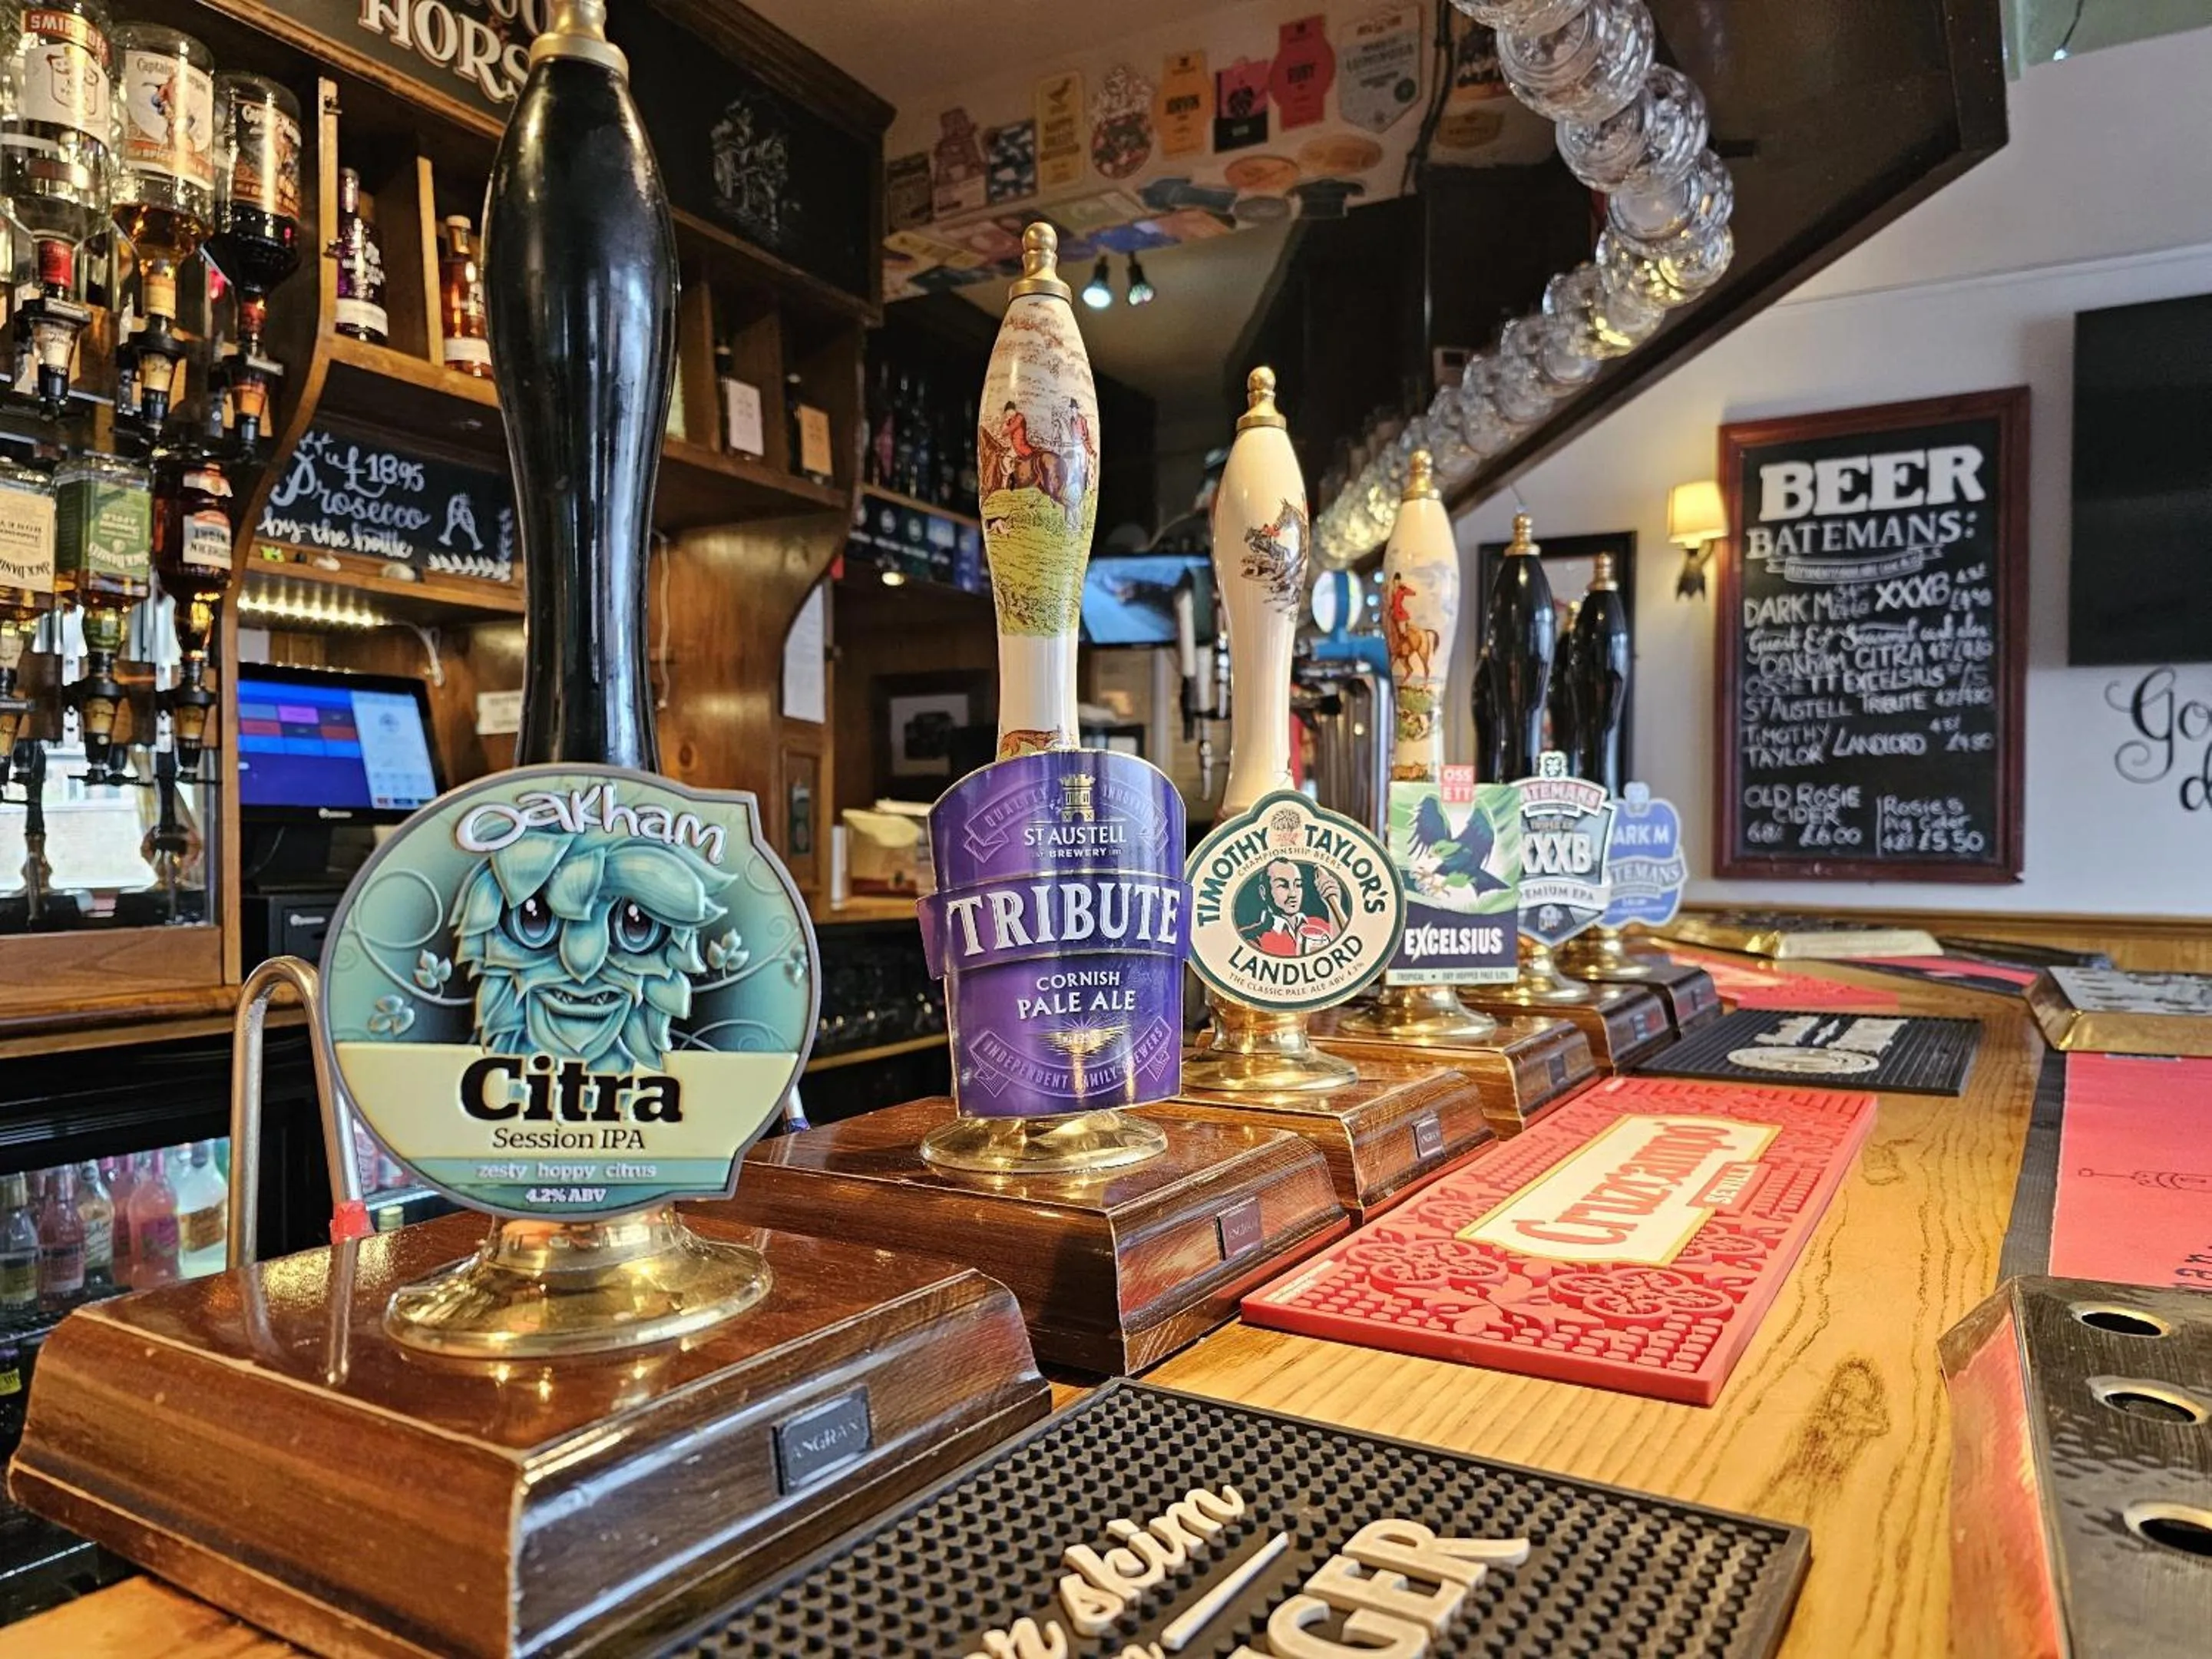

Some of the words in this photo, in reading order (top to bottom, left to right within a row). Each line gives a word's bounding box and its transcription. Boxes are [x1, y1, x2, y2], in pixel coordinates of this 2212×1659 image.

[359, 0, 530, 103] HORS
[270, 451, 431, 530] Prosecco
[1759, 444, 1986, 521] BEER
[1746, 510, 1977, 560] BATEMANS:
[1875, 572, 1949, 611] XXXB
[1744, 593, 1810, 628] DARK
[1855, 643, 1925, 669] CITRA
[1843, 665, 1945, 693] EXCELSIUS
[1769, 696, 1853, 722] AUSTELL
[2104, 666, 2212, 785] Go
[1522, 781, 1601, 810] ATEMANS
[1744, 783, 1793, 809] OLD
[456, 782, 726, 864] Oakham
[1050, 825, 1127, 846] AUSTELL
[1613, 823, 1651, 845] ARK
[1049, 847, 1107, 858] BREWERY
[1237, 846, 1311, 878] CHAMPIONSHIP
[1313, 851, 1342, 870] BEERS
[1198, 826, 1268, 927] TIMOTHY
[1304, 823, 1389, 914] TAYLOR'S
[1612, 861, 1681, 883] TEMANS
[1520, 886, 1569, 900] EMIUM
[1572, 887, 1594, 901] EPA
[947, 882, 1181, 957] TRIBUTE
[1404, 921, 1503, 963] EXCELSIUS
[1228, 935, 1363, 986] LANDLORD
[1037, 971, 1120, 991] CORNISH
[1228, 973, 1244, 986] THE
[1247, 981, 1283, 996] CLASSIC
[1285, 987, 1306, 996] PALE
[1310, 983, 1326, 994] ALE
[1017, 991, 1082, 1020] PALE
[1089, 990, 1136, 1012] ALE
[982, 1040, 1068, 1089] INDEPENDENT
[1076, 1068, 1118, 1090] AMILY
[1123, 1026, 1164, 1076] EWERS
[458, 1055, 683, 1122] Citra
[492, 1127, 594, 1150] Session
[600, 1129, 646, 1150] IPA
[476, 1163, 528, 1180] zesty
[537, 1162, 596, 1180] hoppy
[605, 1162, 657, 1178] citrus
[1511, 1122, 1737, 1245] Cruzcampo
[568, 1188, 607, 1202] ABV
[1060, 1485, 1245, 1638] skim
[1228, 1519, 1530, 1659] GER
